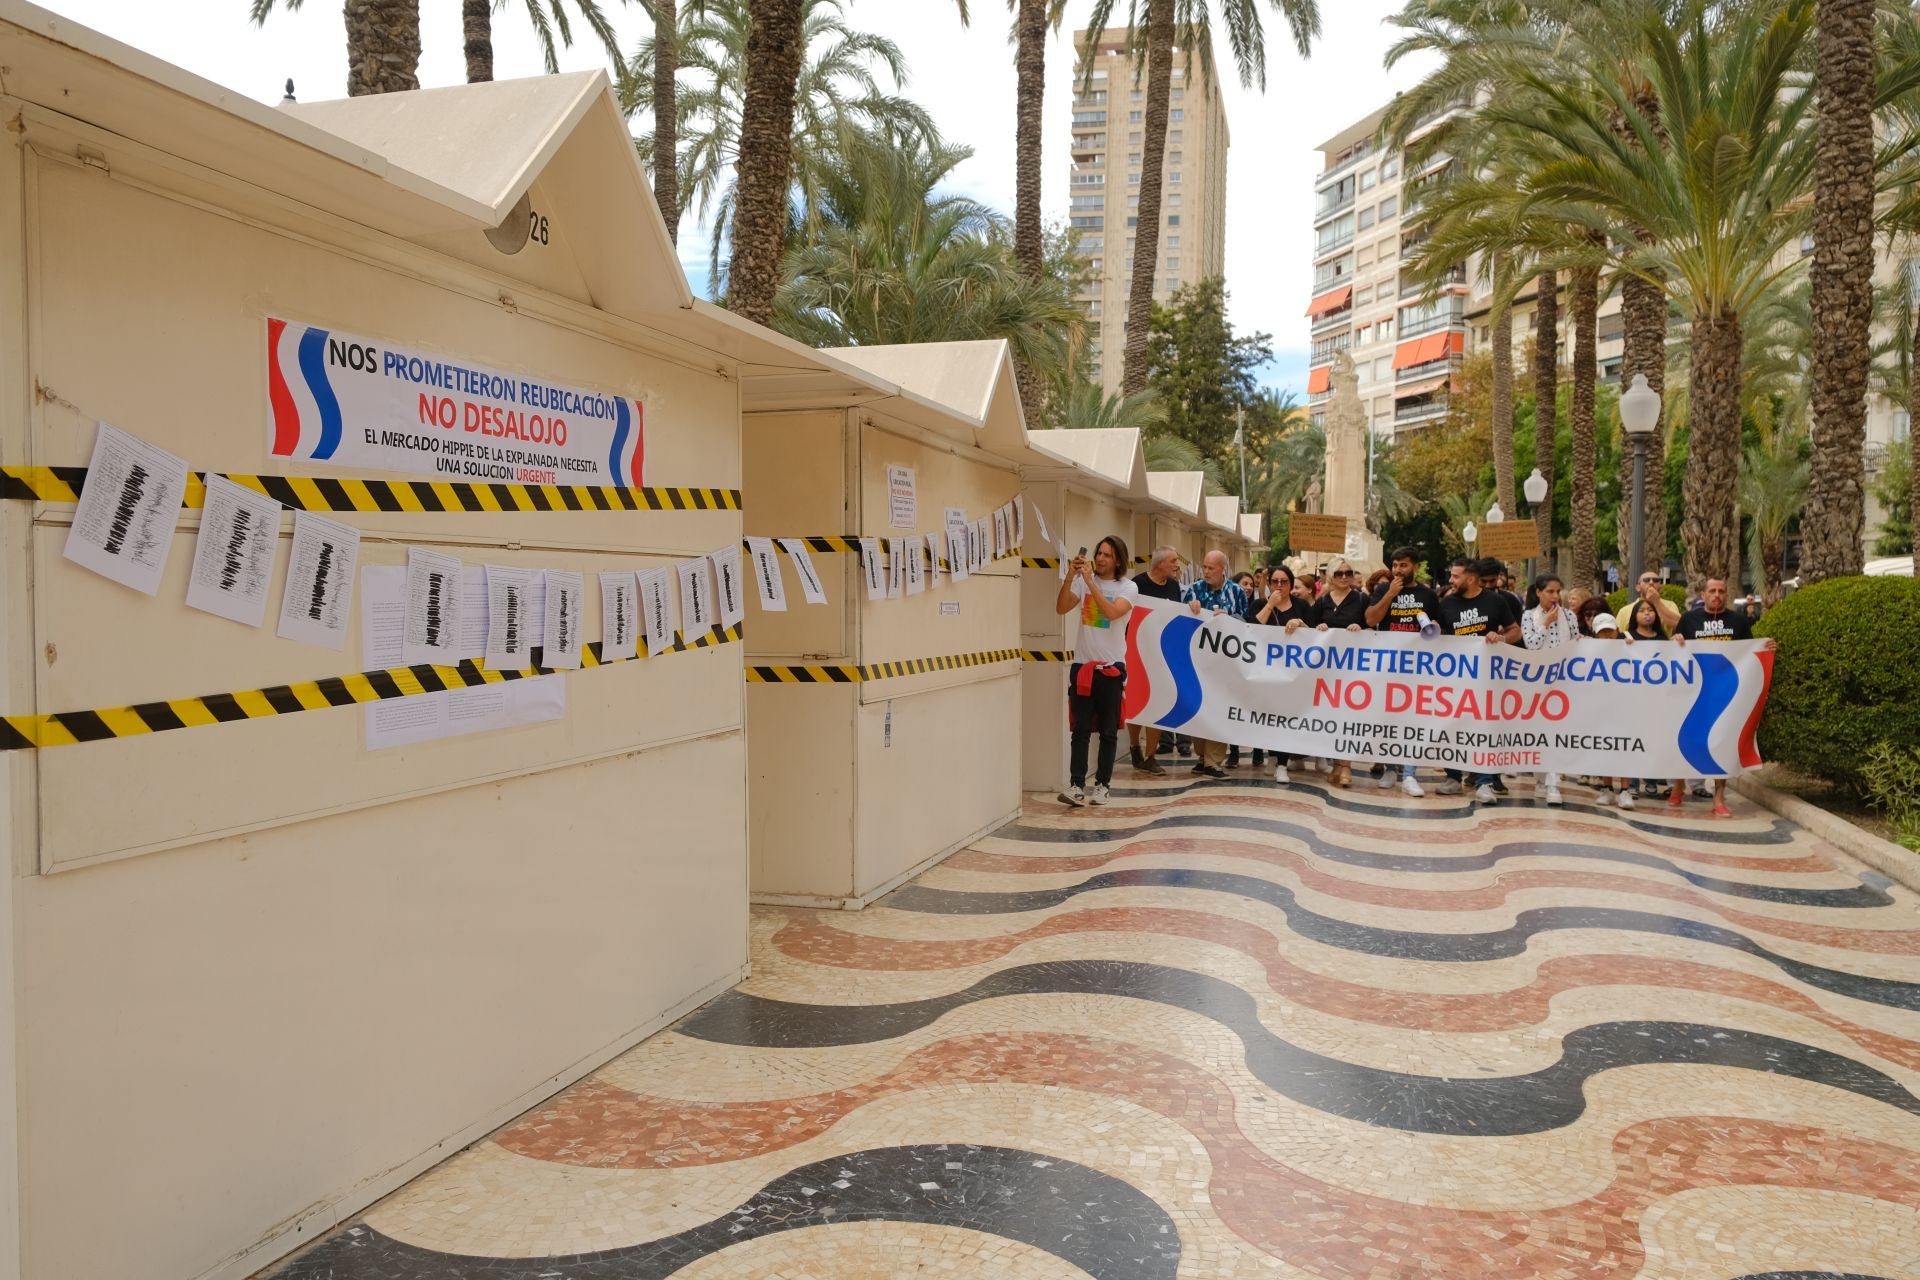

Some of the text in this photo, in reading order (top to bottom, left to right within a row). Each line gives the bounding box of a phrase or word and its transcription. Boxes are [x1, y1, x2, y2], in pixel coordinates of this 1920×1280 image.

[531, 211, 549, 246] 26
[329, 338, 616, 421] NOS PROMETIERON REUBICACIÓN
[418, 392, 568, 447] NO DESALOJO
[364, 428, 598, 474] EL MERCADO HIPPIE DE LA EXPLANADA NECESITA
[436, 457, 557, 485] UNA SOLUCION URGENTE
[1391, 608, 1420, 616] REUBICACIÓ
[1397, 594, 1415, 604] NOS
[1460, 608, 1478, 621] NOS
[1704, 619, 1724, 630] NOS
[1198, 627, 1695, 685] NOS PROMETIERON REUBICACIÓN
[1312, 677, 1570, 722] NO DESALOJO
[1227, 706, 1645, 753] EL MERCADO HIPPIE DE LA EXPLANADA NECESITA
[1333, 738, 1541, 766] UNA SOLUCION URGENTE
